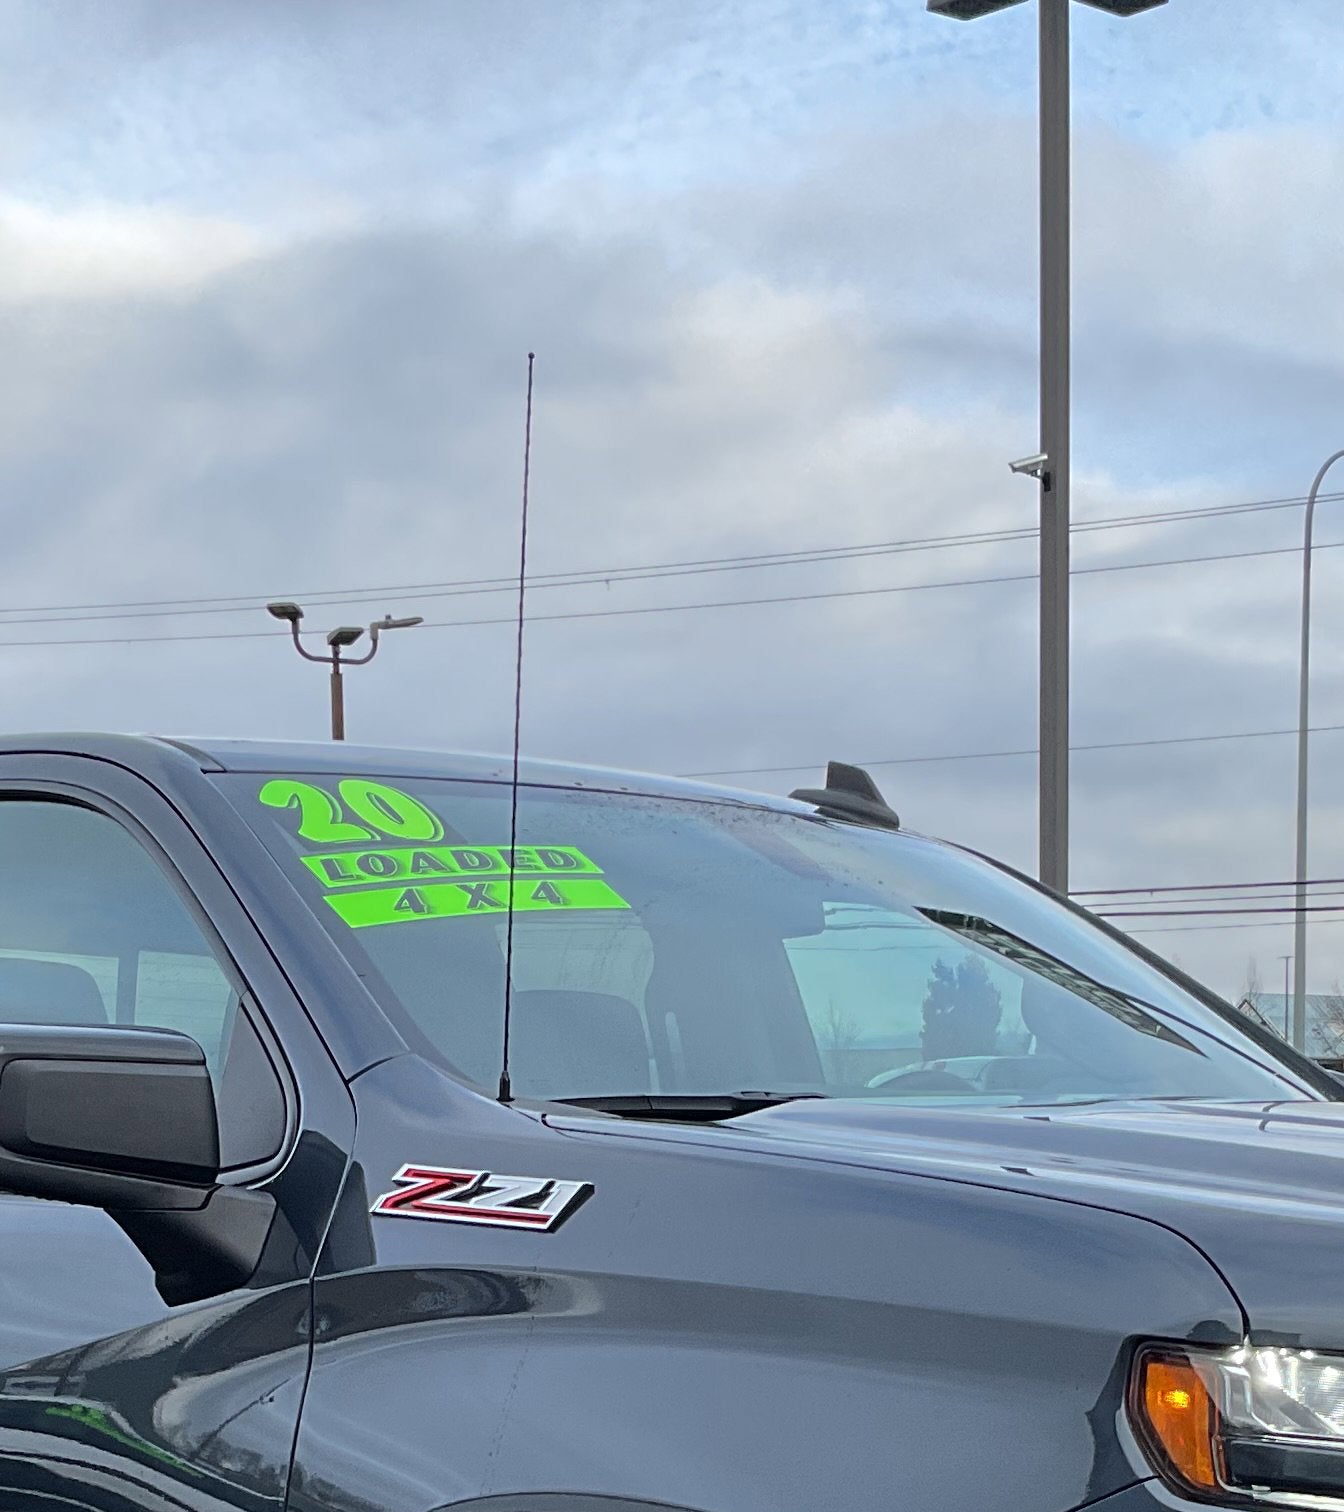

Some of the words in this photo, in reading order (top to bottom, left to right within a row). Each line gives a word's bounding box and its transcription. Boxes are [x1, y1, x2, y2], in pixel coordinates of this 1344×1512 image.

[259, 779, 445, 843] 20
[318, 848, 580, 882] LOADED
[369, 1163, 595, 1234] Z71
